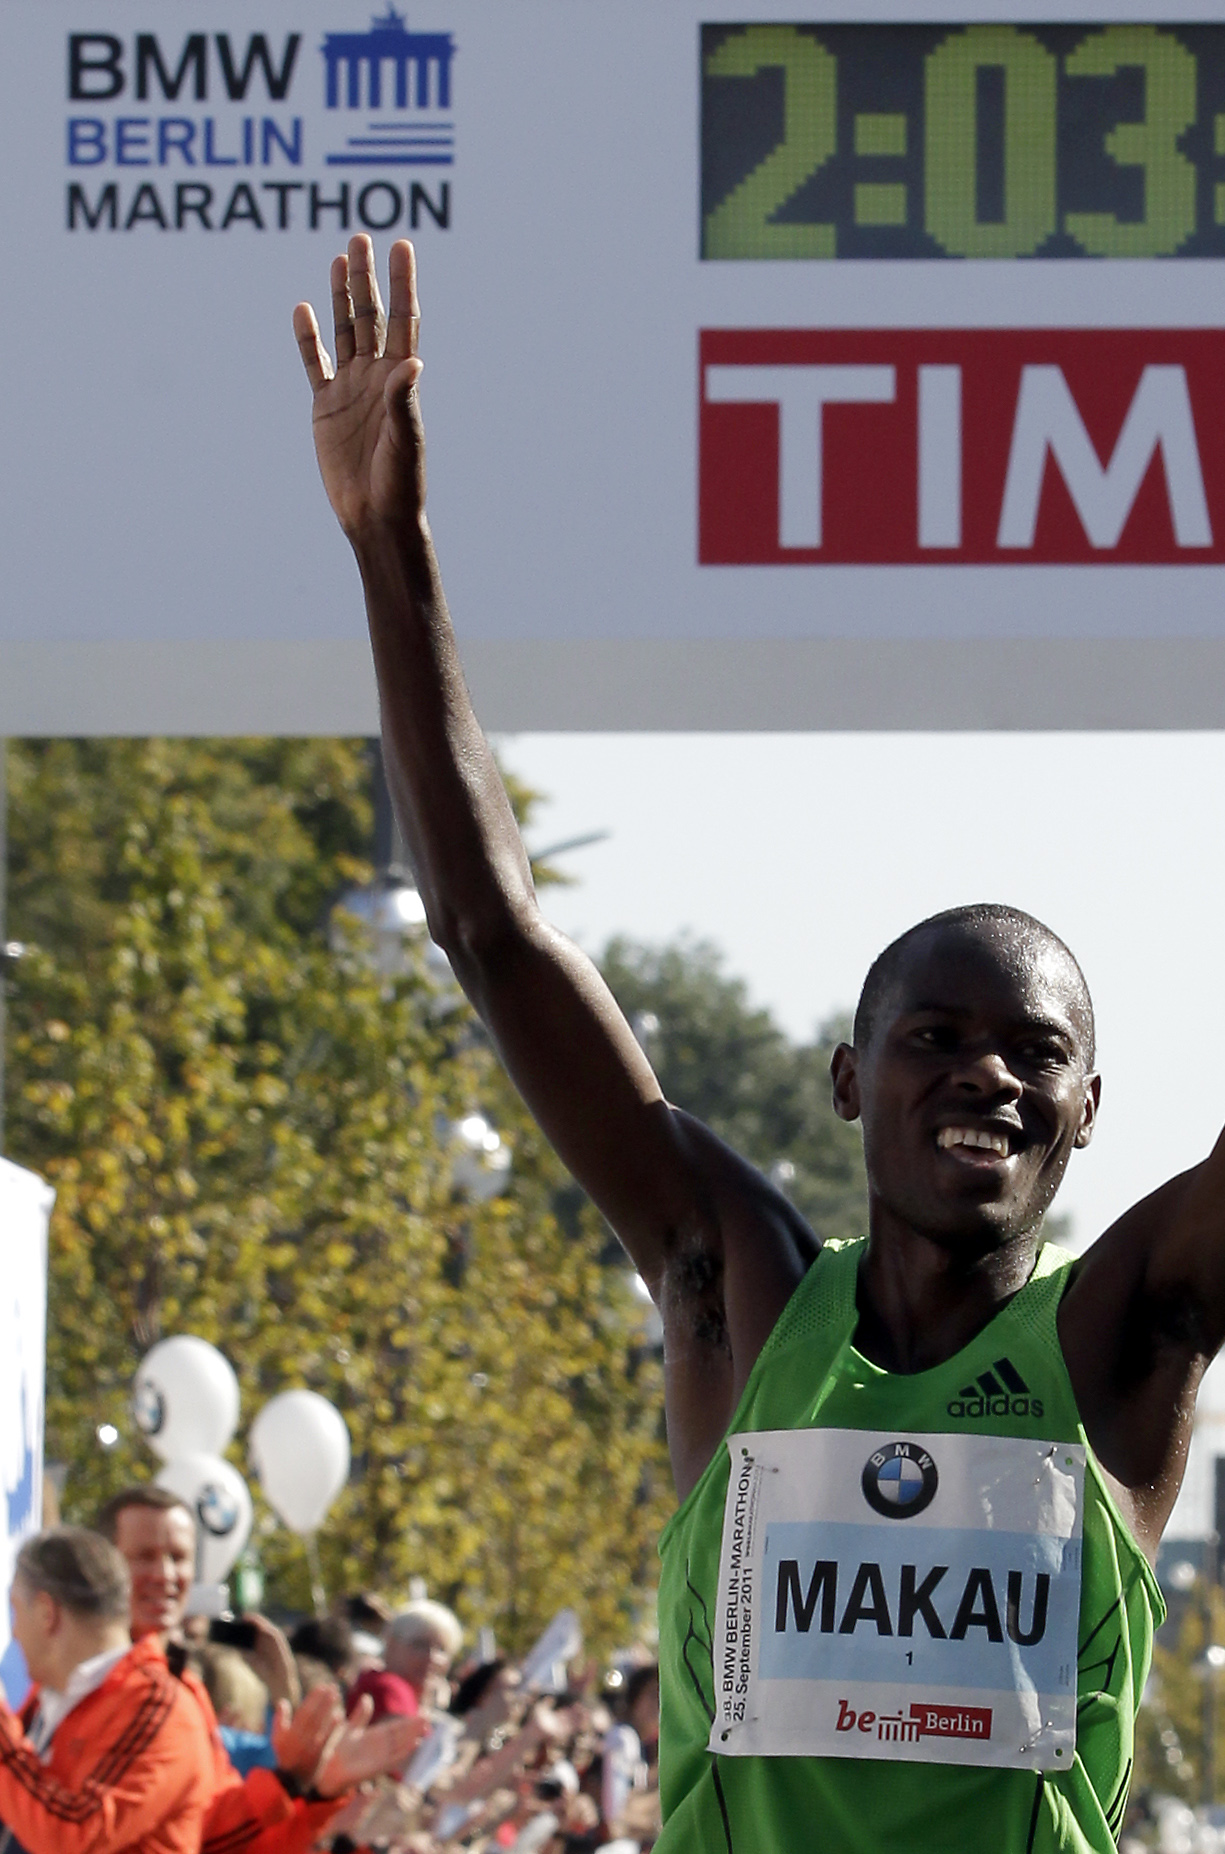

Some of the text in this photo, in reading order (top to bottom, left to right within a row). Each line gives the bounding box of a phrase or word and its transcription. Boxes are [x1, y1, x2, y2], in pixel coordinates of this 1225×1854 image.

[68, 33, 302, 101] BMW
[67, 118, 303, 166] BERLIN
[67, 182, 451, 231] MARATHON
[947, 1394, 1044, 1418] adidas
[869, 1443, 933, 1470] BMW
[726, 1465, 753, 1643] BERLIN-MARATHON
[741, 1568, 753, 1604] 2011
[775, 1559, 1051, 1647] MAKAU
[723, 1646, 737, 1692] BMW
[736, 1608, 751, 1694] September
[905, 1651, 914, 1666] 1
[733, 1697, 747, 1722] 25.
[835, 1699, 984, 1733] be Berlin
